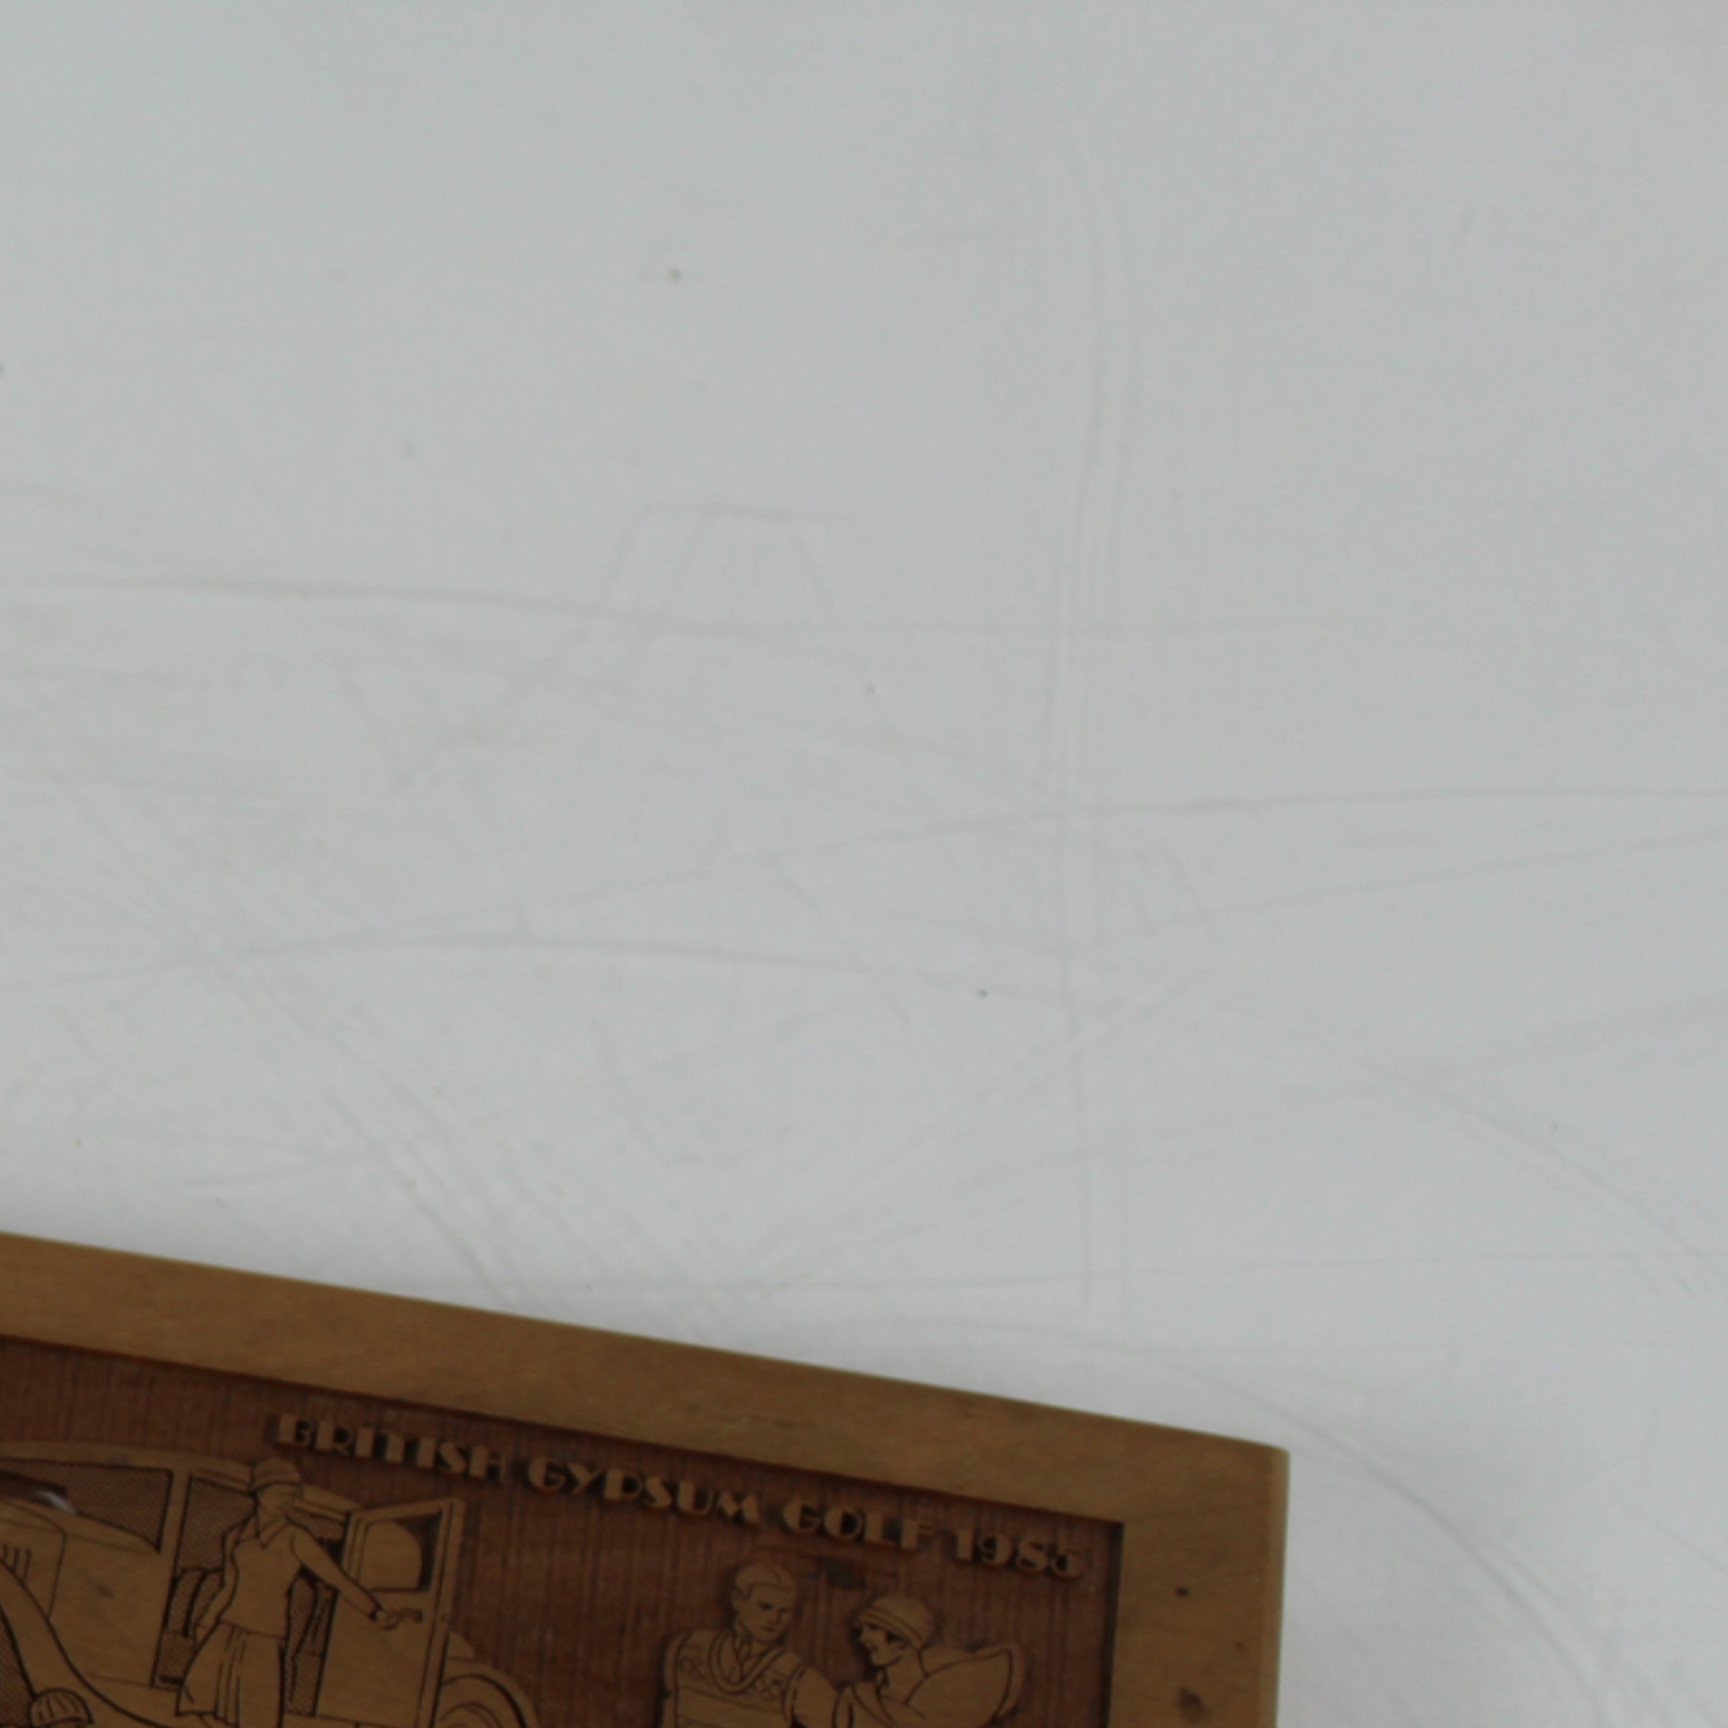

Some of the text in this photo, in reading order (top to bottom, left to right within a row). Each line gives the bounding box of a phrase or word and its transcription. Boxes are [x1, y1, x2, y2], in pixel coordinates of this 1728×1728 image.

[277, 1413, 1088, 1578] BRITISH GYPSUM GOLF 1985
